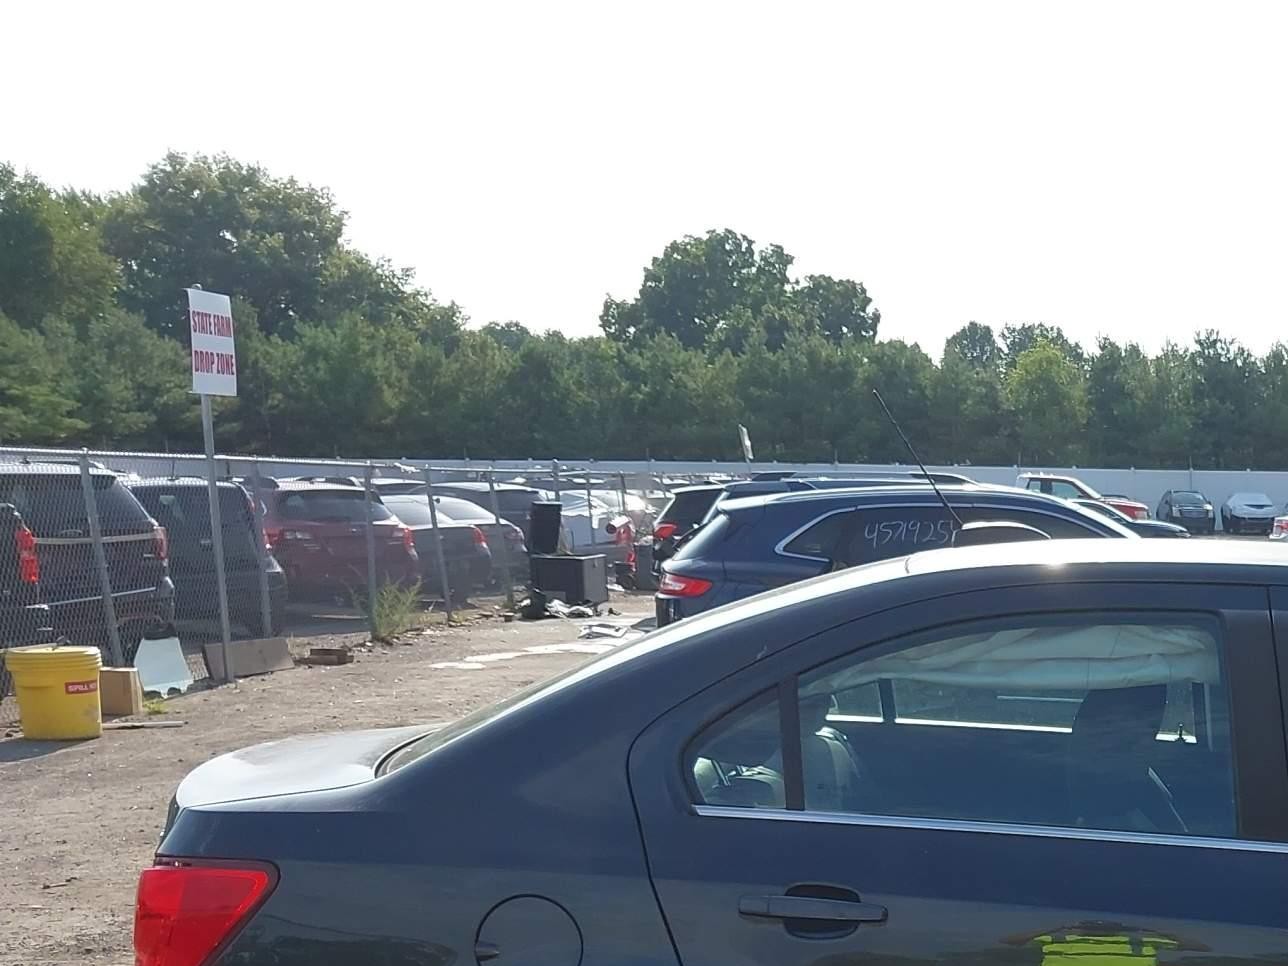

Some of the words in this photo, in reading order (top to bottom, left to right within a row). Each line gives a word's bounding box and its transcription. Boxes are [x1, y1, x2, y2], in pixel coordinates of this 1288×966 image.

[192, 310, 212, 335] STATE
[213, 314, 232, 337] FARM
[194, 349, 214, 374] DROP
[216, 352, 235, 375] ZONE
